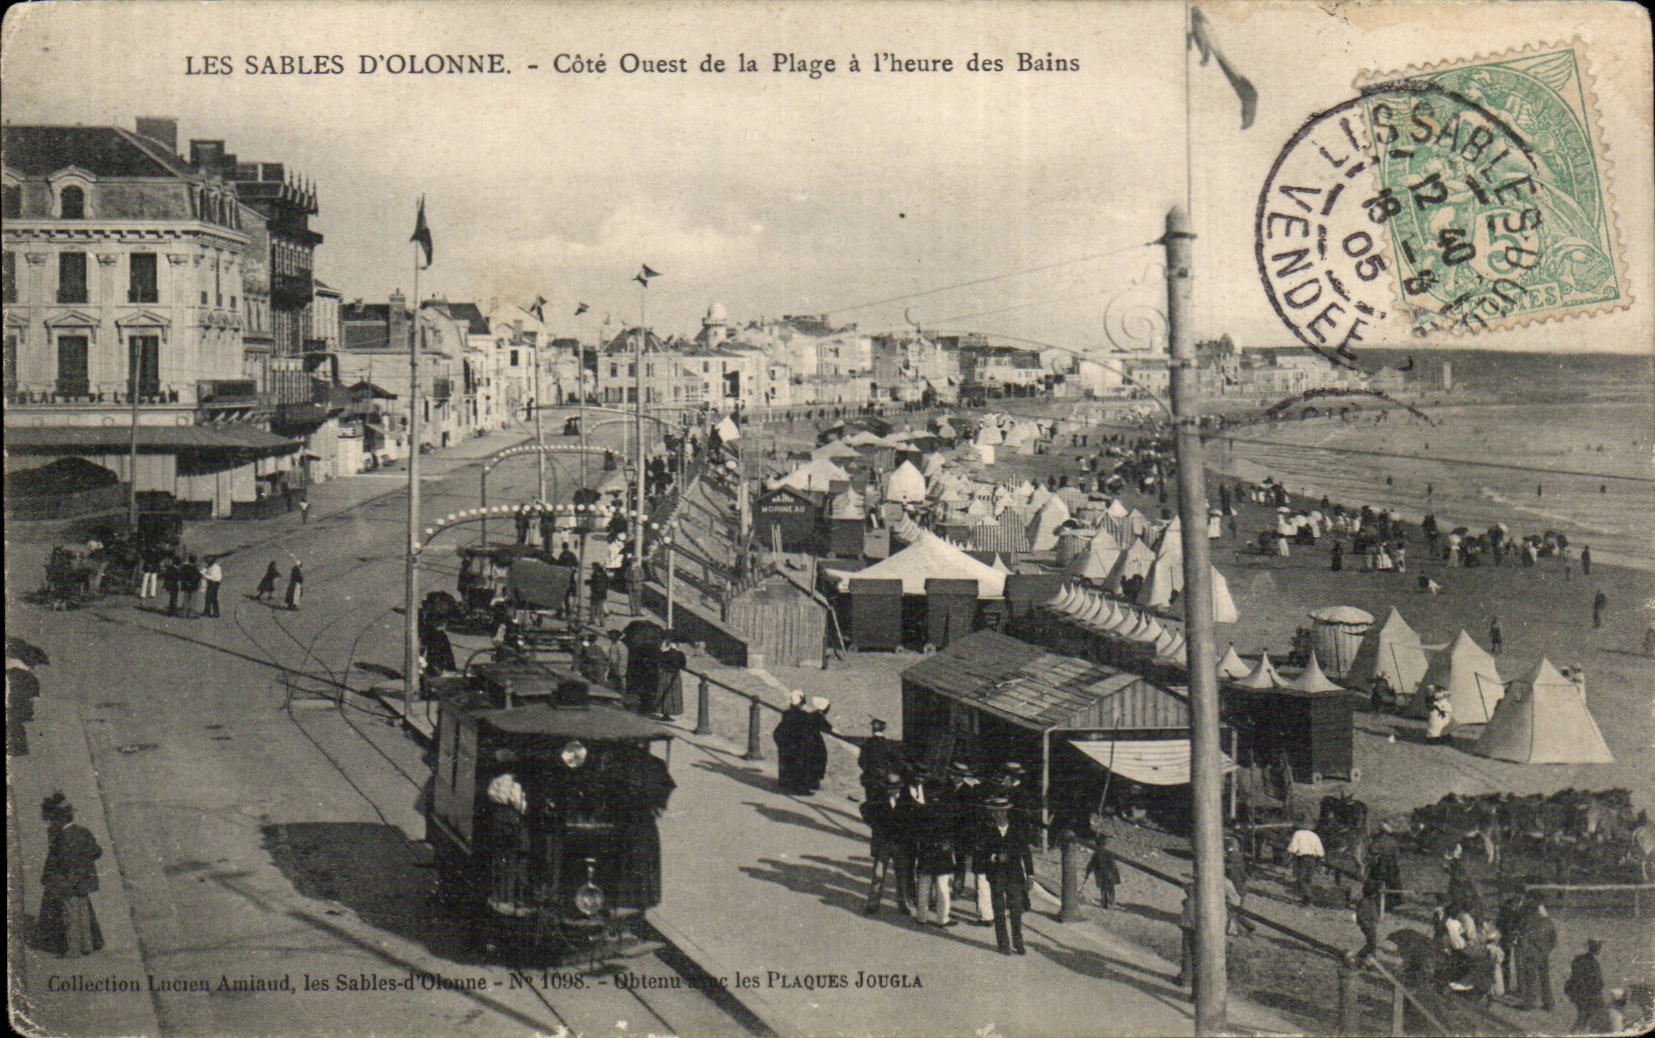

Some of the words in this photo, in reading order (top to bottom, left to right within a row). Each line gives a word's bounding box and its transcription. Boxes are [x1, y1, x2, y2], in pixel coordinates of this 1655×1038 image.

[1266, 185, 1369, 362] VENDEE
[1342, 231, 1387, 282] 05
[761, 505, 806, 513] MORINEAU
